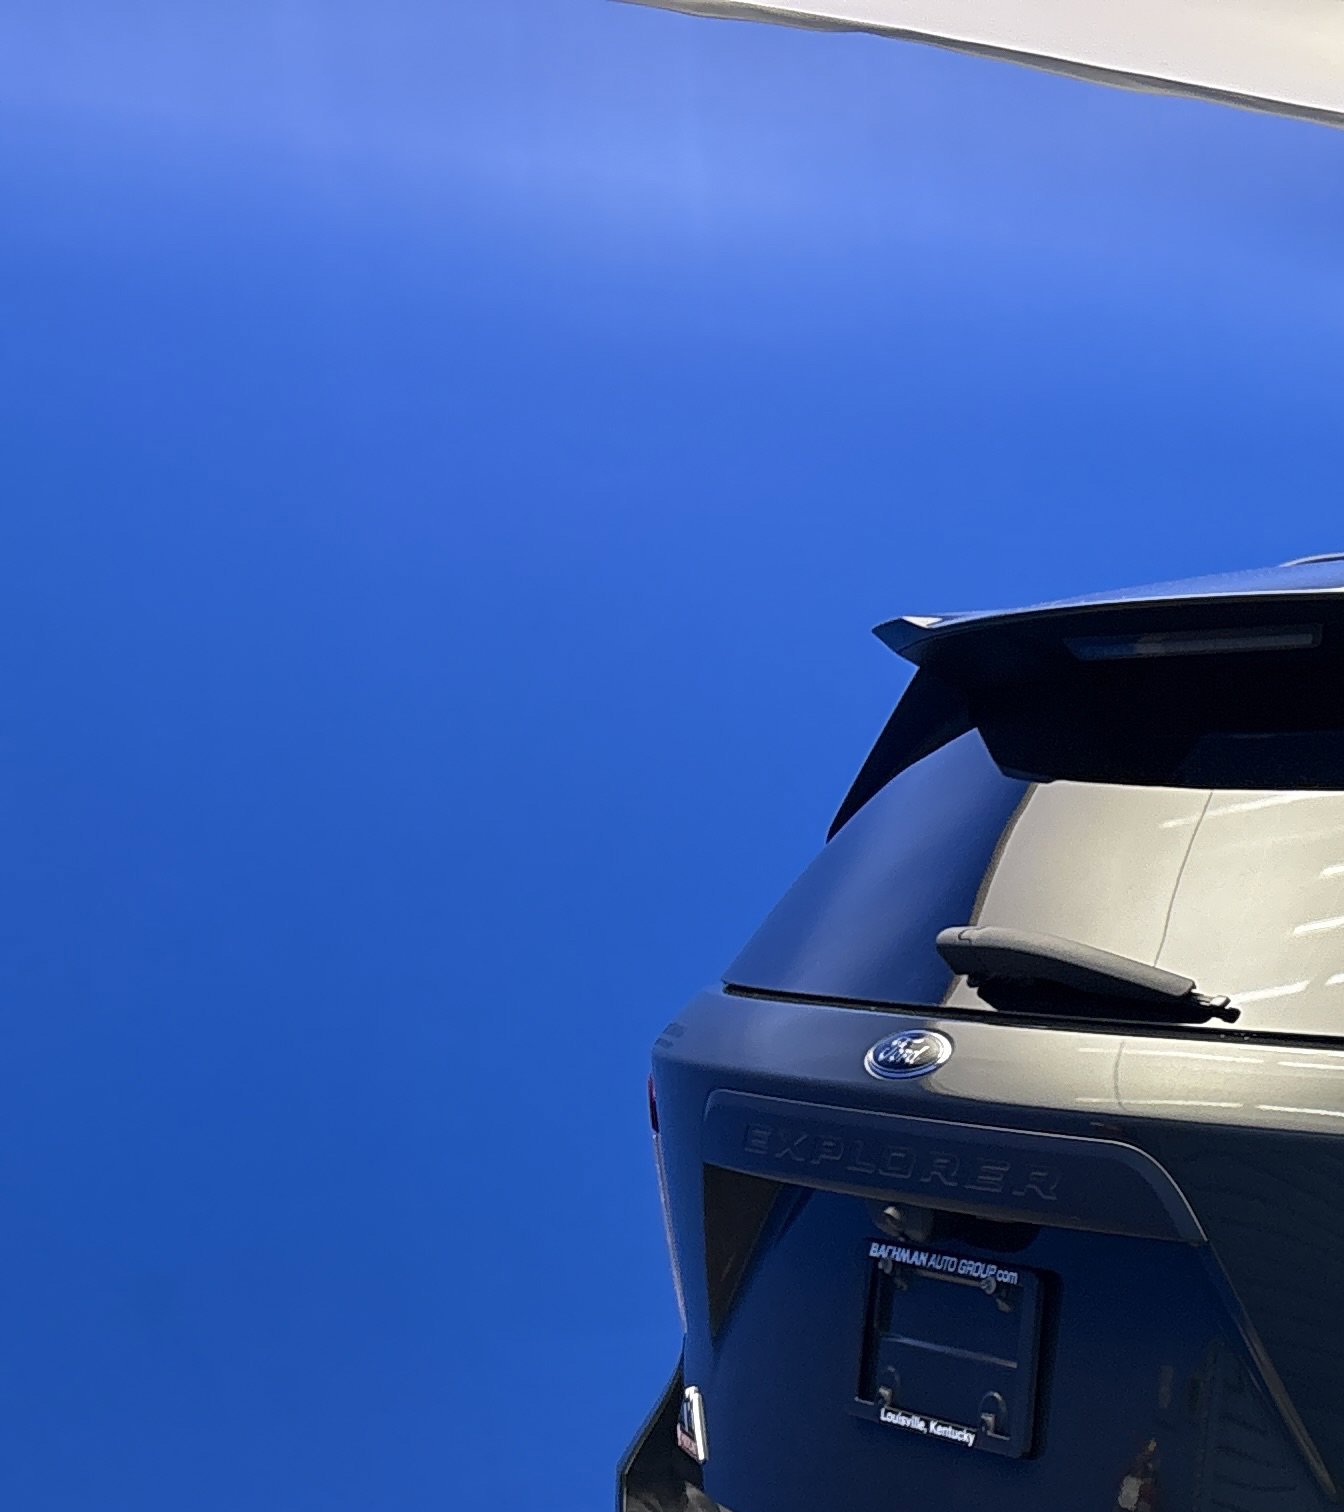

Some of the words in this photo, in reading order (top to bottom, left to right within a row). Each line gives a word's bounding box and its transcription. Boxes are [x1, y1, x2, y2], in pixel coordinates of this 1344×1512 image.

[878, 1036, 930, 1064] Ford
[744, 1123, 1062, 1200] EXPLORER
[927, 1253, 958, 1273] AUTO
[880, 1407, 928, 1434] Louisville,
[929, 1420, 976, 1447] Kentucky
